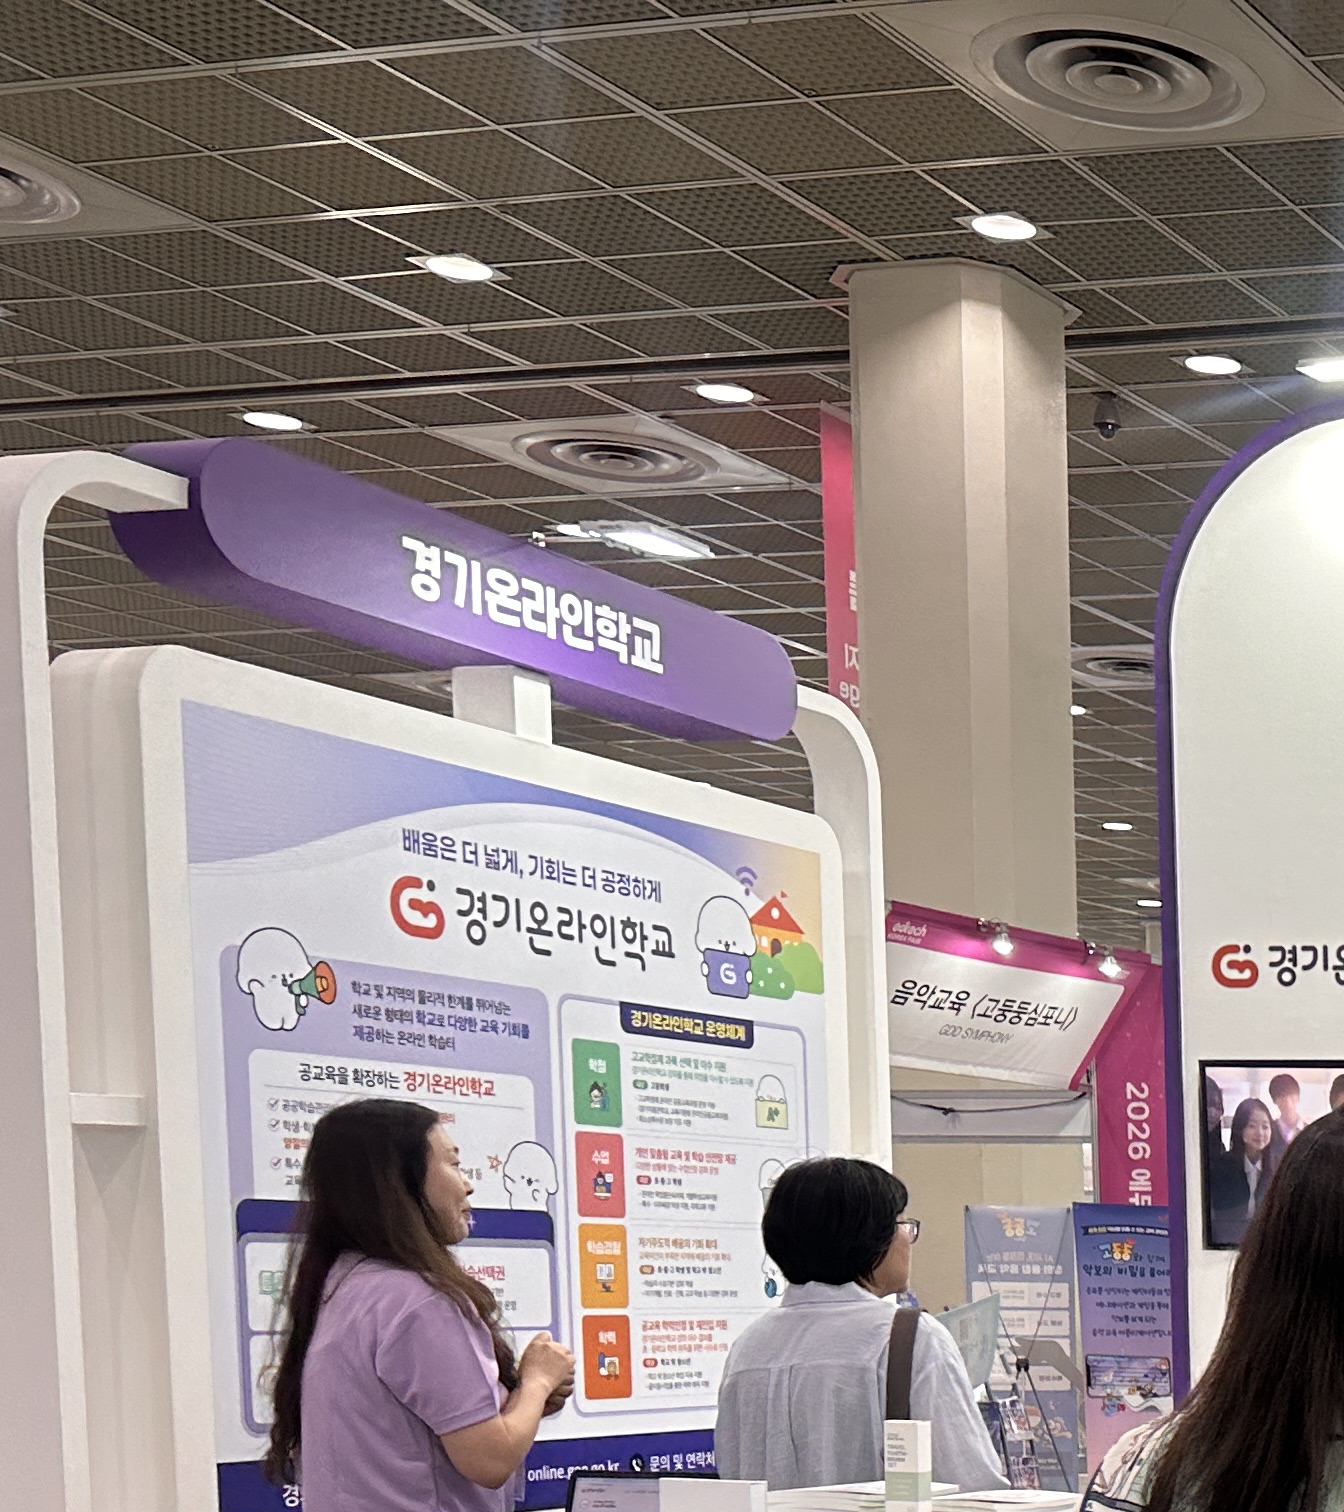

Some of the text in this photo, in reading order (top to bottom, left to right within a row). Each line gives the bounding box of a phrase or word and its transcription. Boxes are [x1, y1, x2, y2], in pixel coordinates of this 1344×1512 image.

[402, 535, 664, 675] 경기온라인학교
[402, 828, 662, 903] 배움은 더 넓게, 기회는 더 공정하게
[455, 886, 676, 973] 경기온라인학교
[351, 980, 371, 997] 학교
[890, 979, 970, 1016] 음악교육
[352, 1003, 382, 1021] 새로운
[480, 1018, 499, 1035] 교육
[630, 1009, 704, 1036] 경기온라인학교
[397, 1029, 425, 1048] 온라인
[298, 1062, 495, 1098] 공교육을 확장하는 경기온라인학교
[1125, 1081, 1151, 1160] 2026
[650, 1455, 671, 1473] 문의
[673, 1453, 684, 1471] 및
[685, 1449, 716, 1470] 연락처
